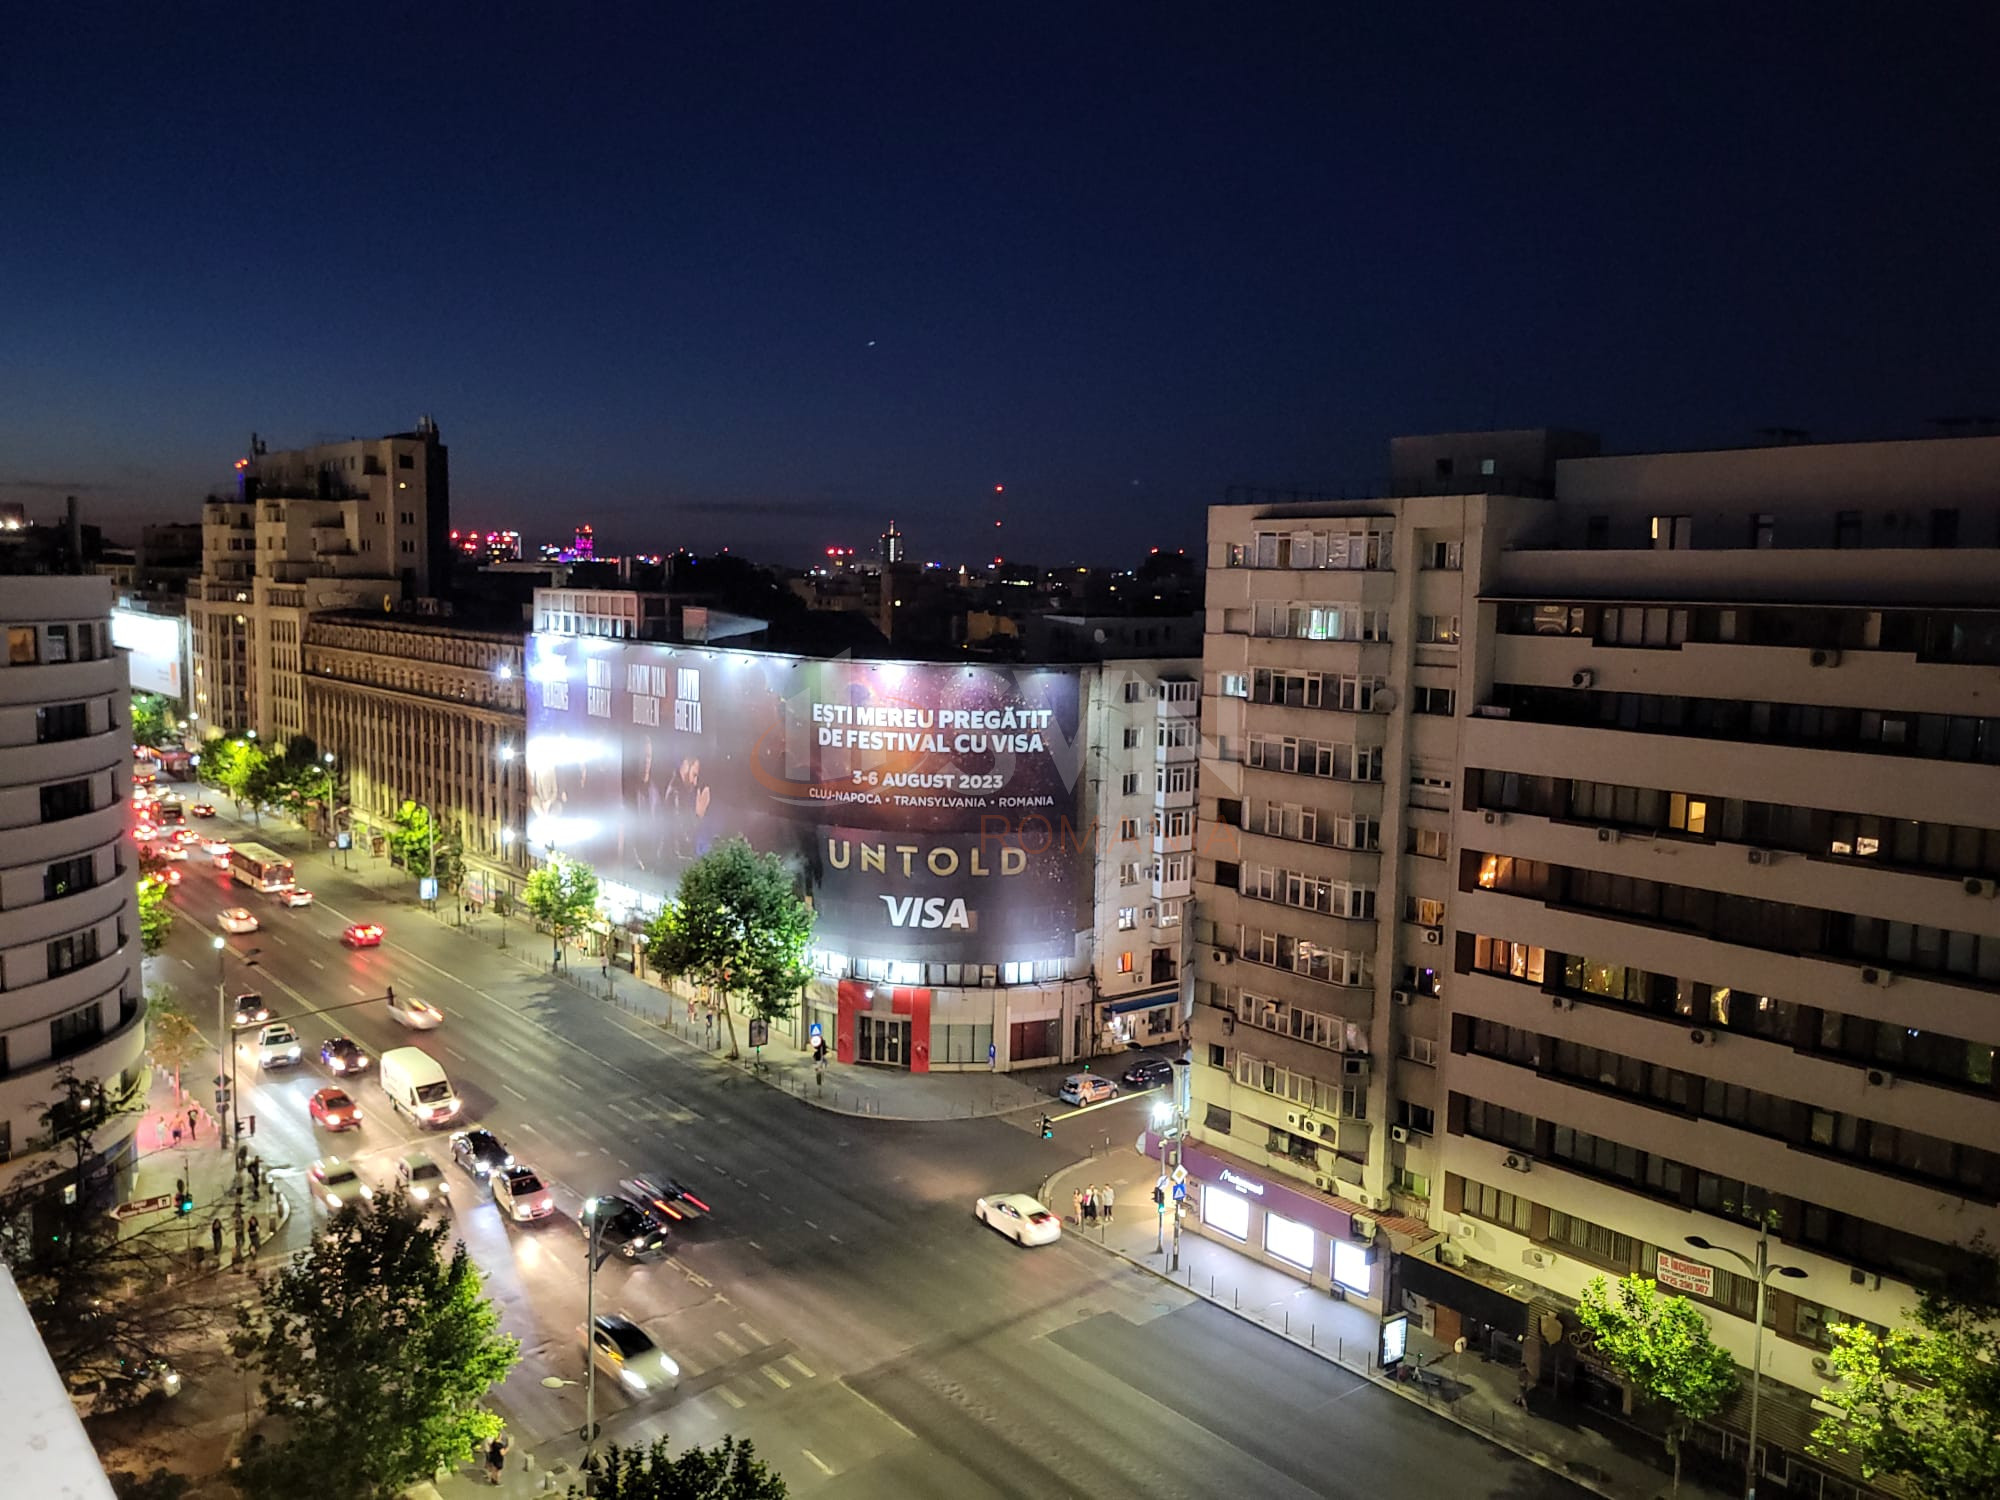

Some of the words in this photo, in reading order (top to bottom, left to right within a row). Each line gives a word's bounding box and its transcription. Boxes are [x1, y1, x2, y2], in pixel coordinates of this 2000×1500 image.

[813, 703, 854, 728] EȘTI
[857, 708, 933, 729] MEREU
[939, 708, 1053, 730] PREGĂTIT
[818, 726, 843, 747] DE
[847, 730, 950, 753] FESTIVAL
[955, 733, 988, 753] CU
[991, 733, 1044, 753] VISA
[852, 769, 878, 787] 3-6
[882, 771, 954, 789] AUGUST
[958, 772, 1004, 789] 2023
[808, 787, 882, 805] CLUJ-NAPOCA
[893, 794, 987, 808] TRANSYLVANIA
[998, 795, 1055, 808] ROMANIA
[828, 839, 1027, 878] UNTOLD
[879, 895, 970, 930] VISA
